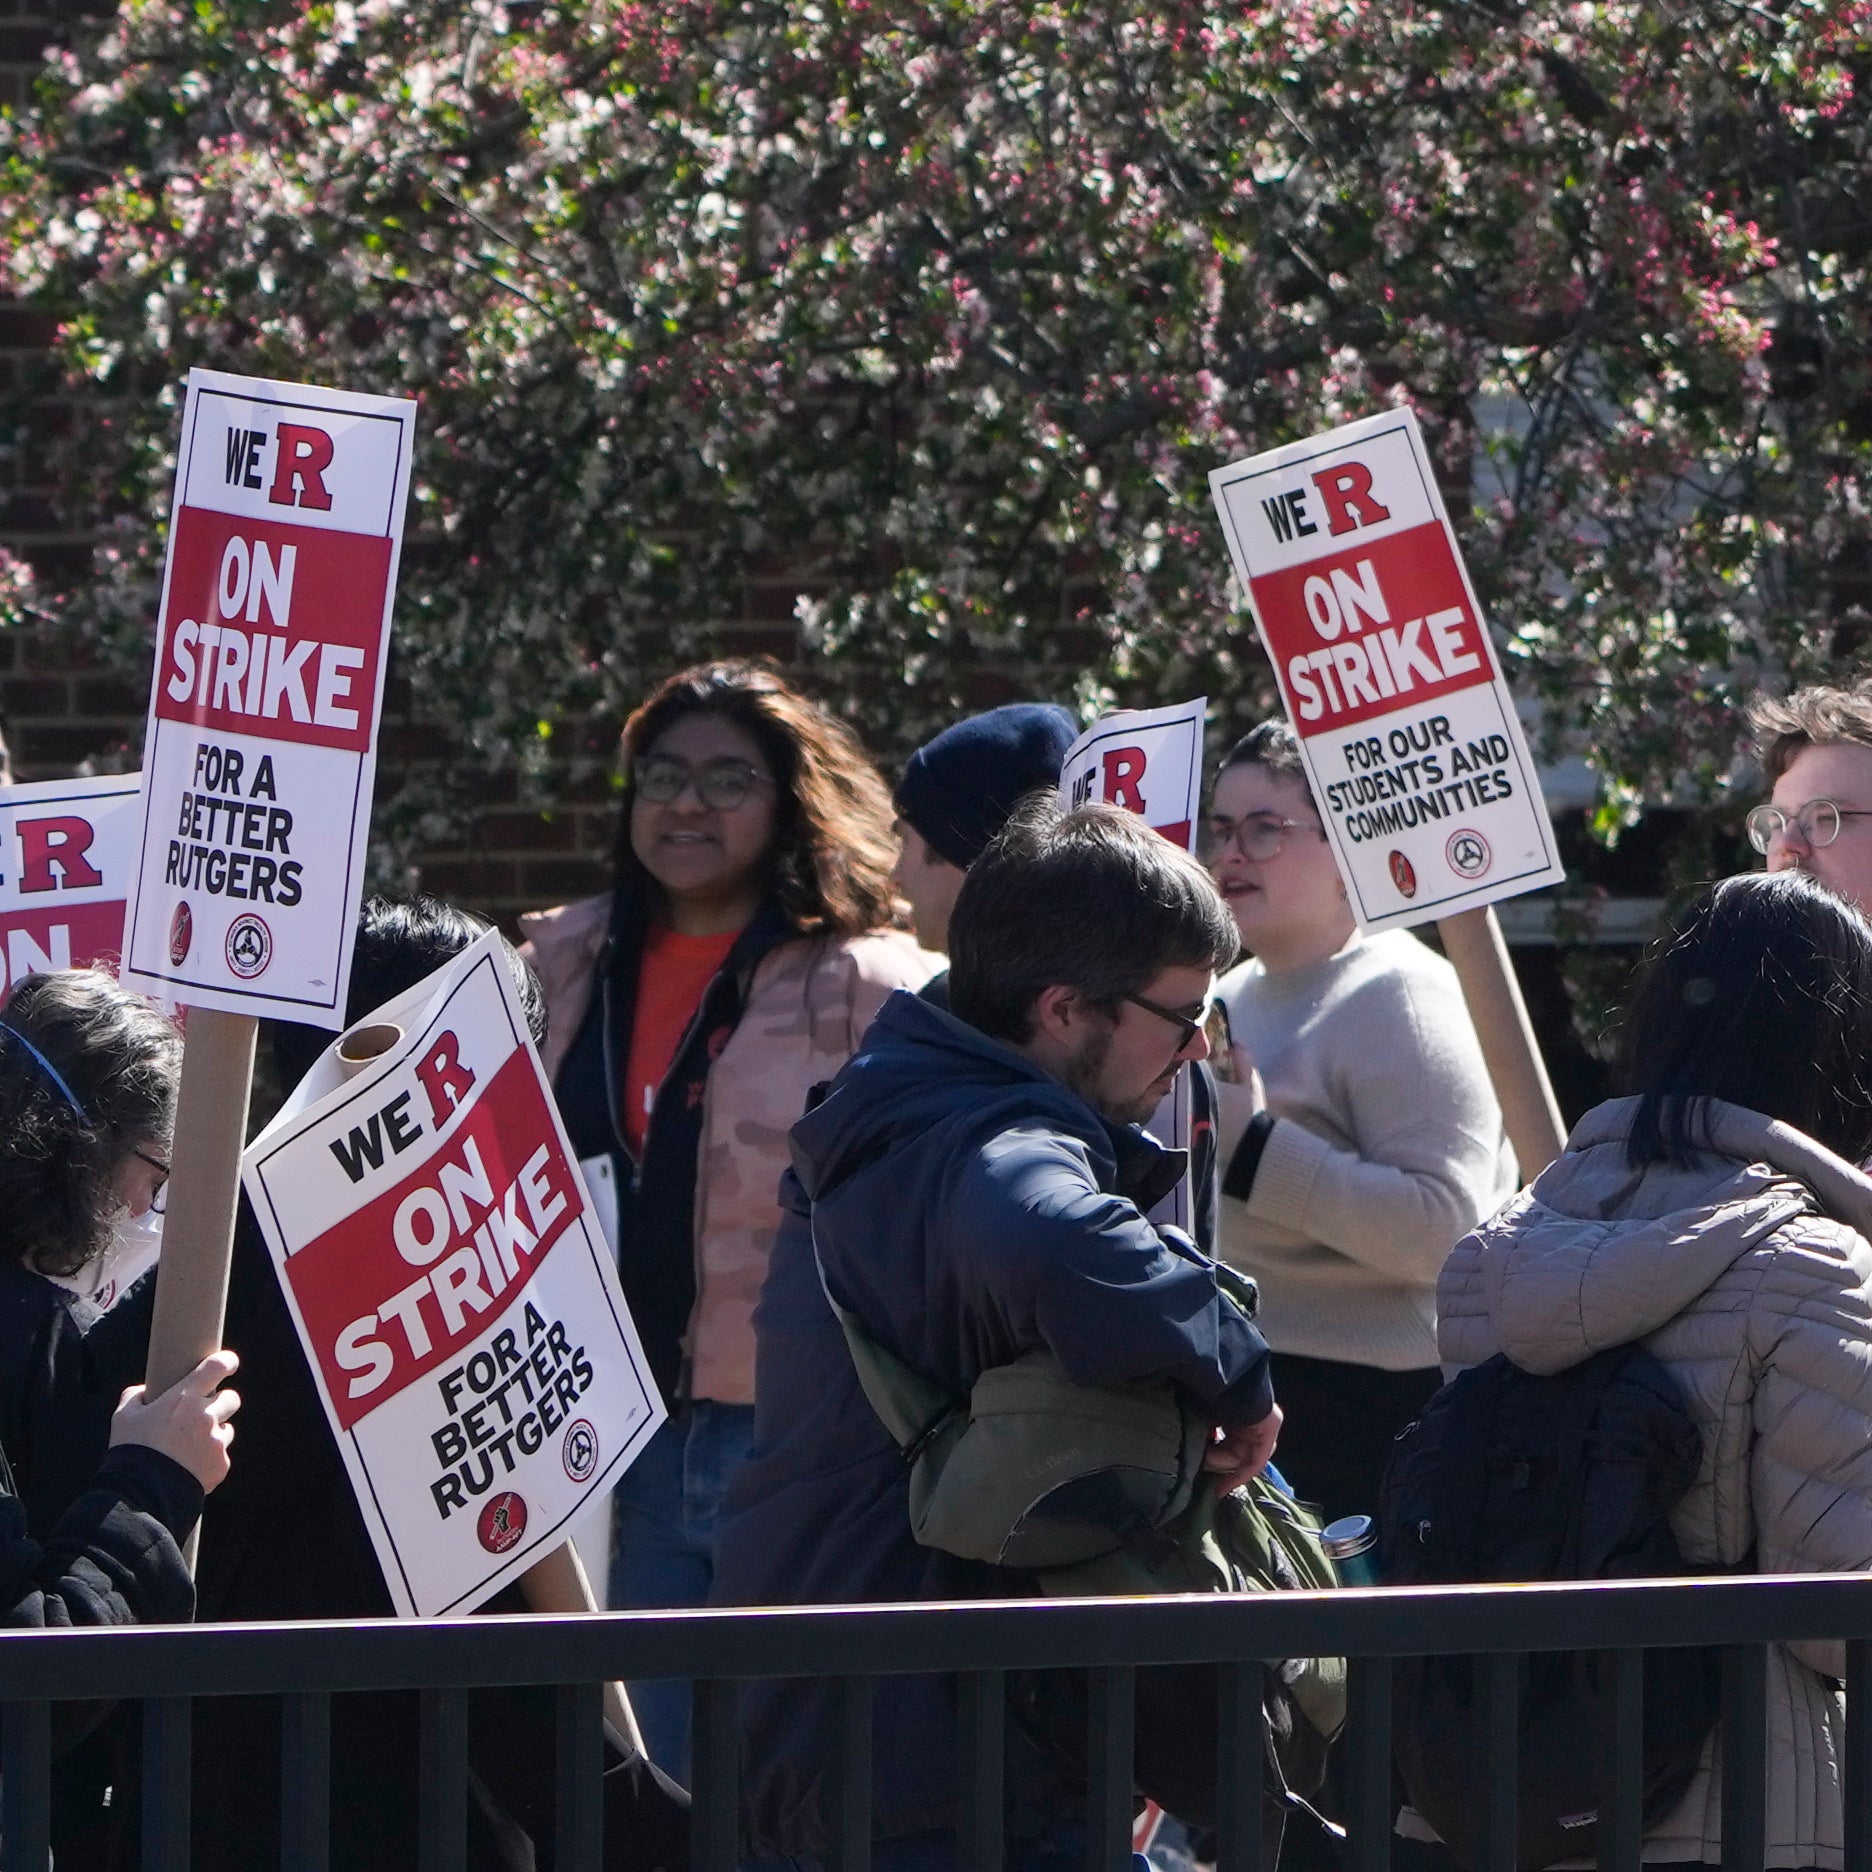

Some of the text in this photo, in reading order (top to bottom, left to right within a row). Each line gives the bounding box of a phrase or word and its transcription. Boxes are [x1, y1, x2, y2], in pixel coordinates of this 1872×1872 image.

[225, 422, 334, 512] WE R
[1261, 461, 1391, 544] WE R
[218, 534, 297, 628] ON
[1303, 559, 1391, 641] ON
[166, 617, 366, 731] STRIKE
[1288, 606, 1481, 722] STRIKE
[193, 743, 277, 802] FOR A
[1103, 746, 1147, 815] R
[1326, 734, 1510, 813] STUDENTS AND
[1342, 715, 1456, 773] FOR OUR
[179, 791, 294, 855] BETTER
[1344, 769, 1513, 844] COMMUNITIES
[16, 815, 102, 893] R
[165, 839, 304, 908] RUTGERS
[330, 1029, 477, 1186] WE R
[392, 1134, 494, 1267] ON
[334, 1142, 568, 1400] STRIKE
[430, 1319, 572, 1471] BETTER
[437, 1301, 549, 1416] FOR A
[430, 1346, 595, 1519] RUTGERS
